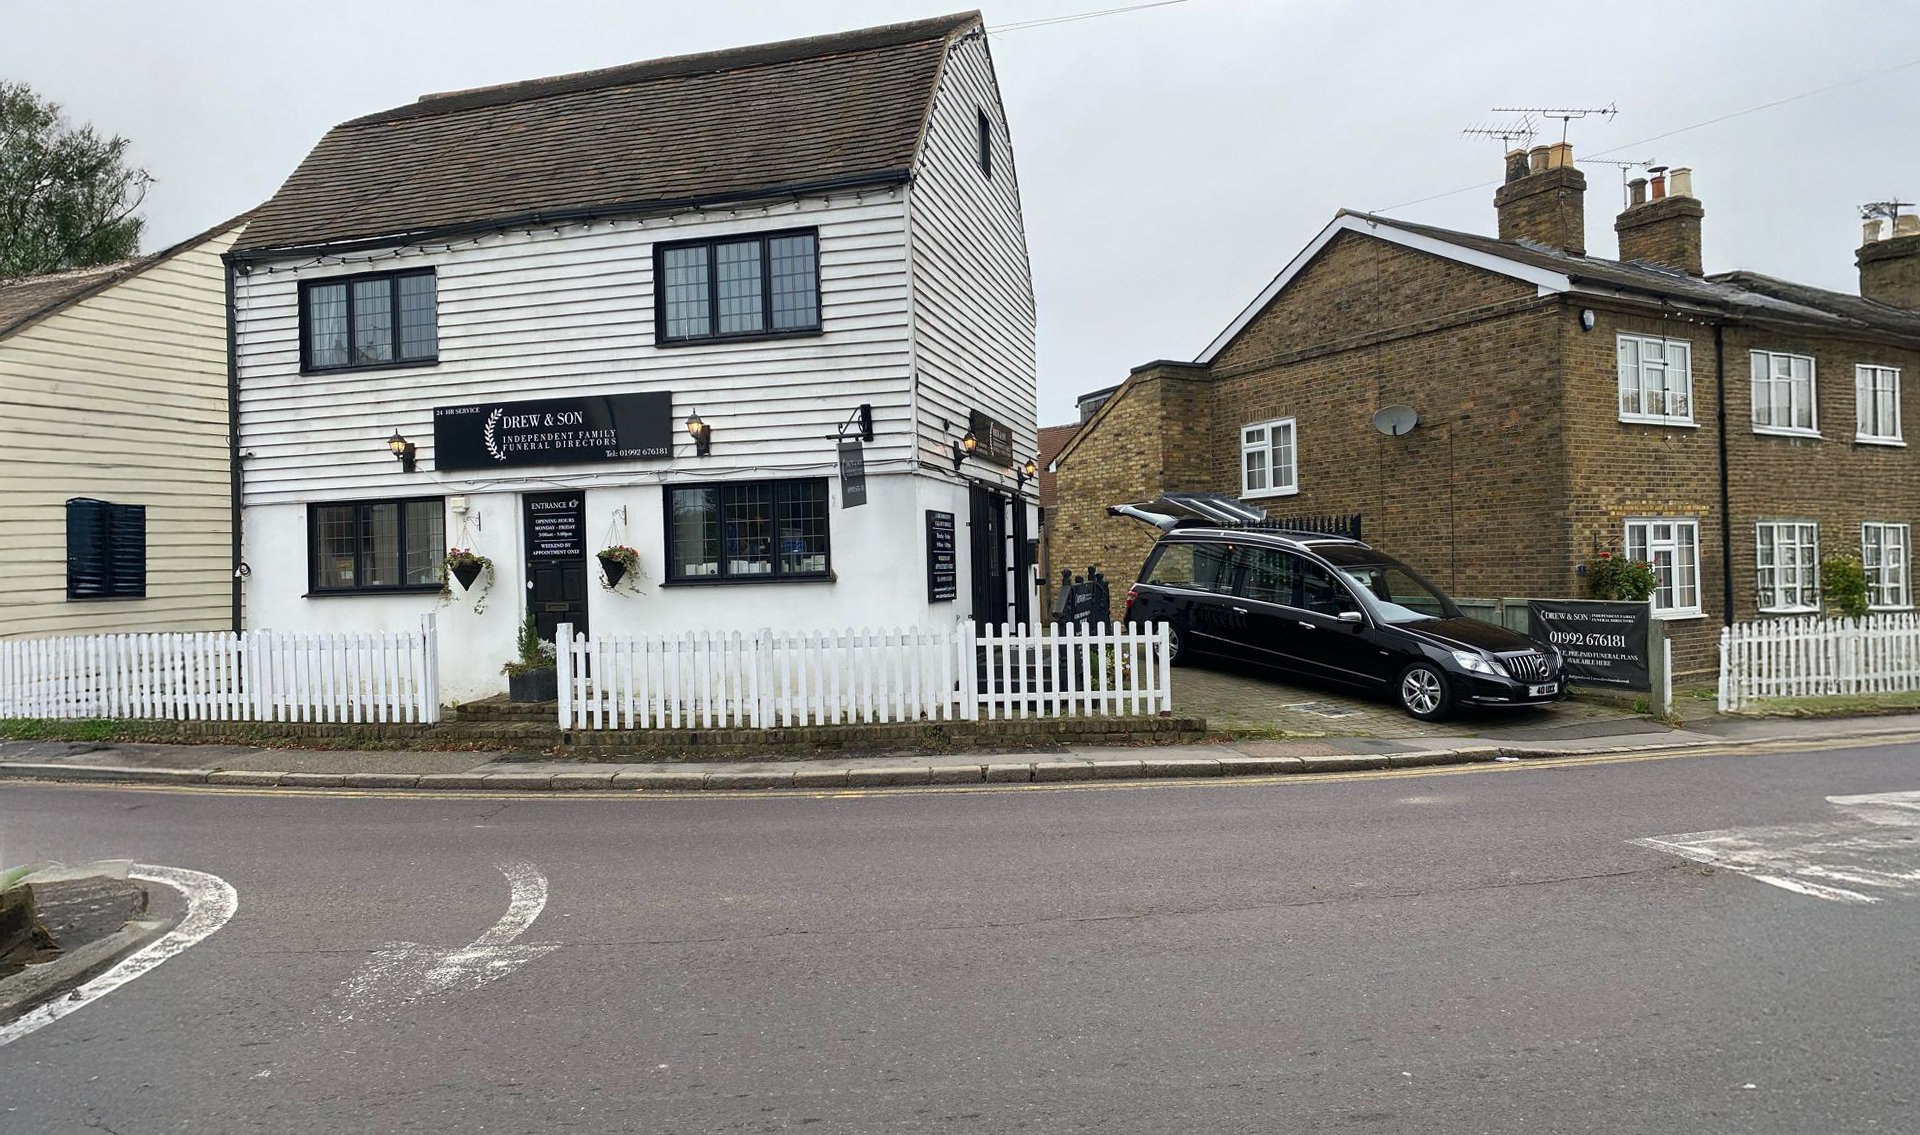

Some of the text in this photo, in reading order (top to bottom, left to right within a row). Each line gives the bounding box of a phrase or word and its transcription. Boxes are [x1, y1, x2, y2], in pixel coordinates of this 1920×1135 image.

[455, 406, 480, 415] SERVICE
[502, 411, 583, 429] DREW & SON
[502, 429, 616, 444] INDEPENDENT FAMILY
[502, 437, 617, 452] FUNERAL DIRECTORS
[619, 448, 641, 456] 01992
[642, 447, 668, 455] 676181
[531, 501, 567, 509] ENTRANCE
[1545, 612, 1566, 621] DREW
[1573, 613, 1589, 621] SON
[1549, 630, 1626, 648] 01992 676181
[1568, 650, 1593, 658] PRE-PAID
[1593, 652, 1620, 660] FUNERAL
[1566, 657, 1612, 667] AVAILABLE HERE
